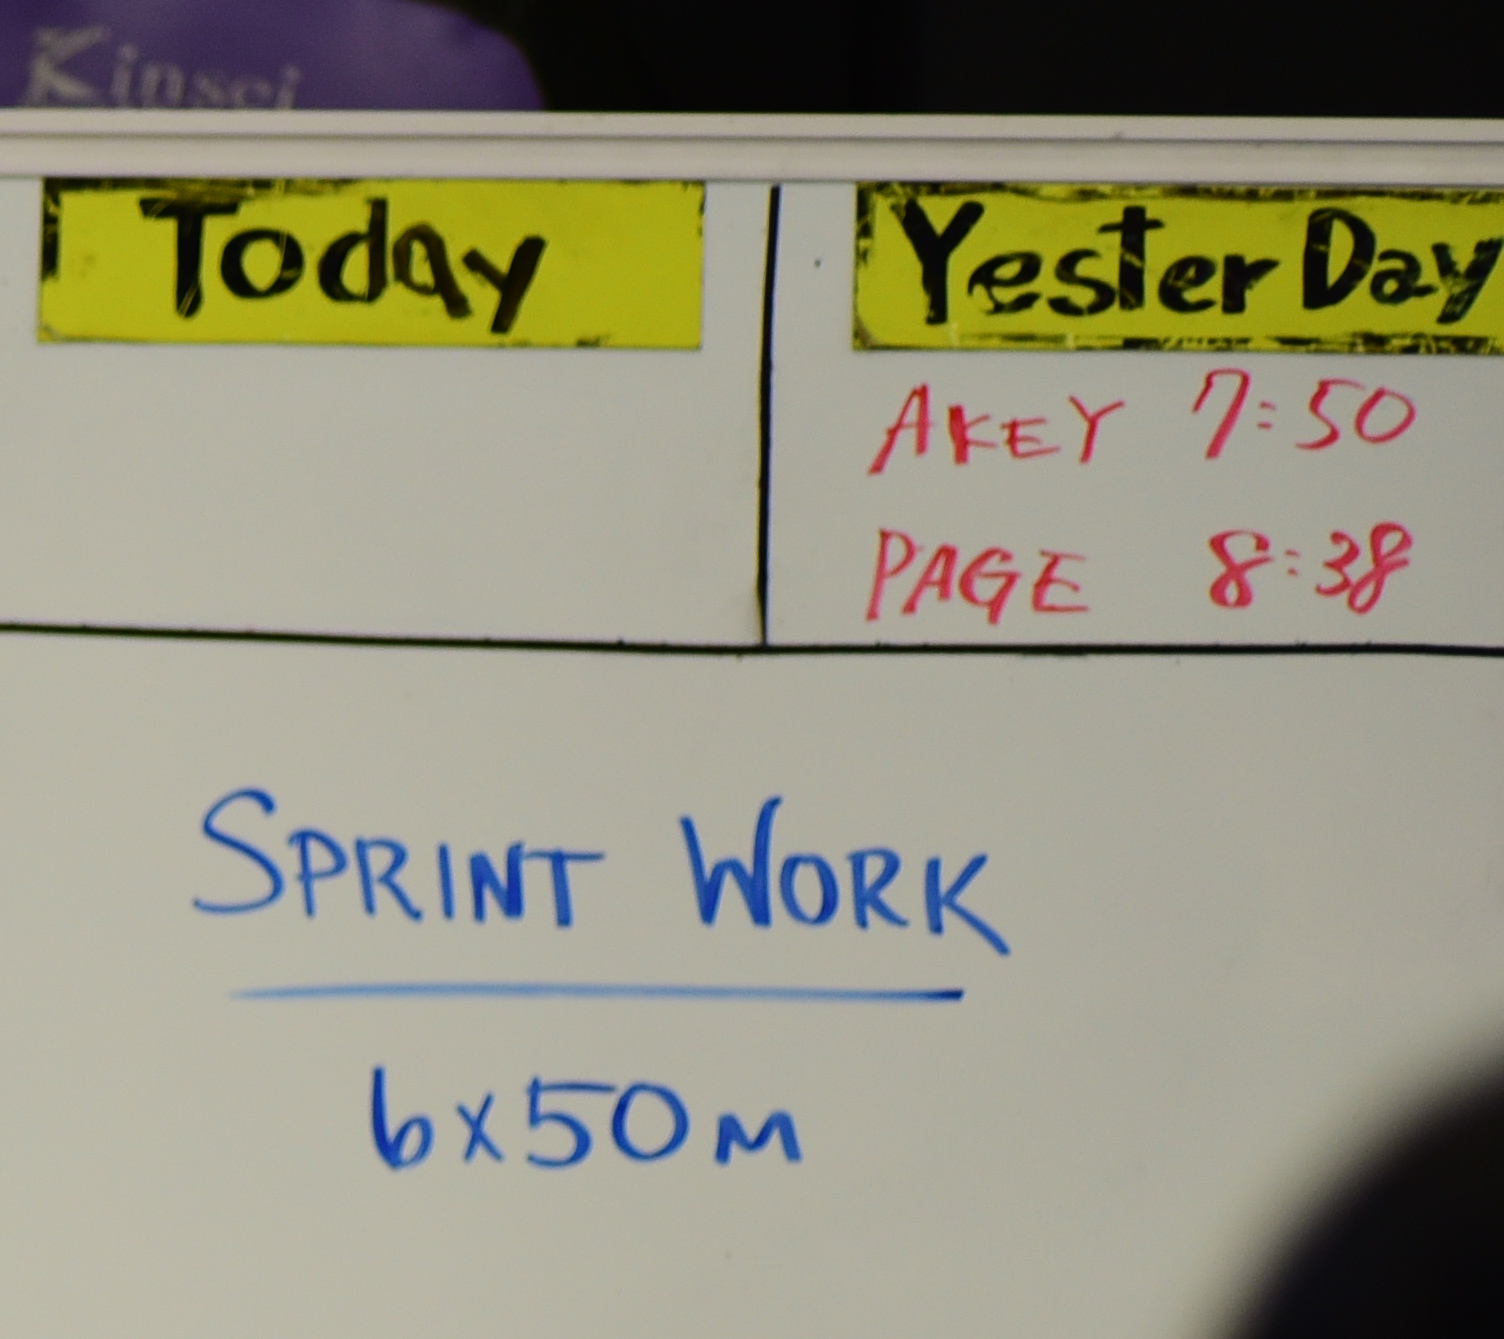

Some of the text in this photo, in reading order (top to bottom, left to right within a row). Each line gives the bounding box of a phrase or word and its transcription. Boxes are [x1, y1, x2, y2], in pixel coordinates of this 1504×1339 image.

[140, 198, 546, 333] Today
[867, 367, 1418, 477] AKEY 7:50
[864, 520, 1415, 627] PAGE 8:38
[194, 787, 1012, 957] SPRINT WORK
